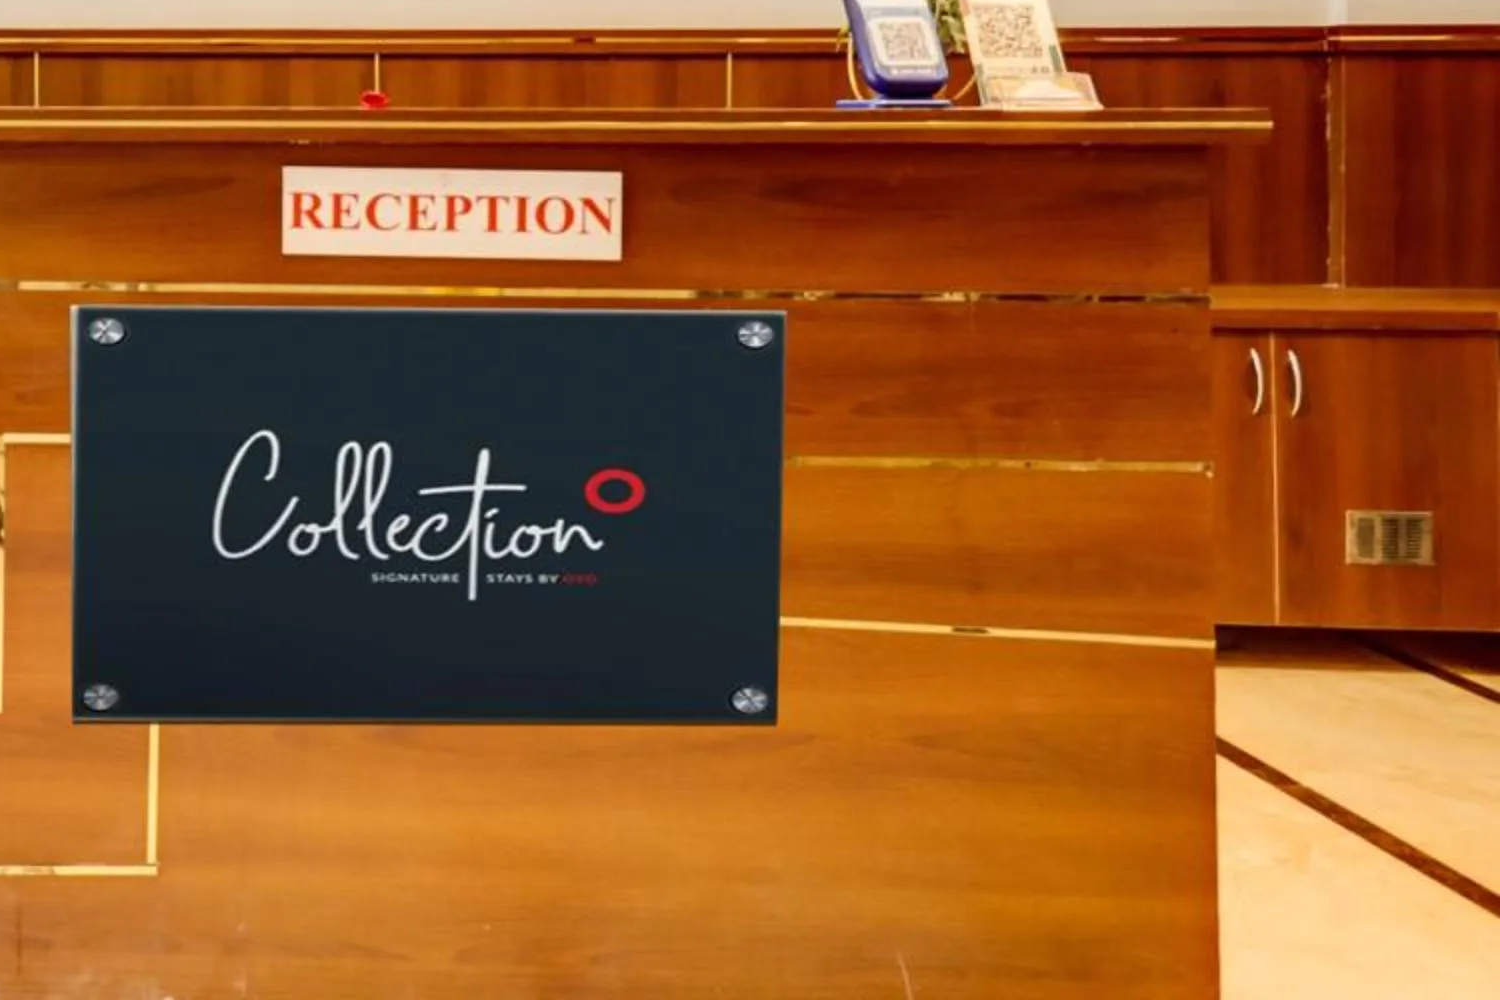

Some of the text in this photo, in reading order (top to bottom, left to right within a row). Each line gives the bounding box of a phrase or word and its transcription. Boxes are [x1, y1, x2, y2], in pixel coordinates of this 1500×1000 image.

[289, 190, 617, 235] RECEPTION
[211, 429, 604, 601] Collection
[371, 572, 460, 584] SIGNATURE
[486, 572, 534, 584] STAYS
[537, 573, 558, 584] BY
